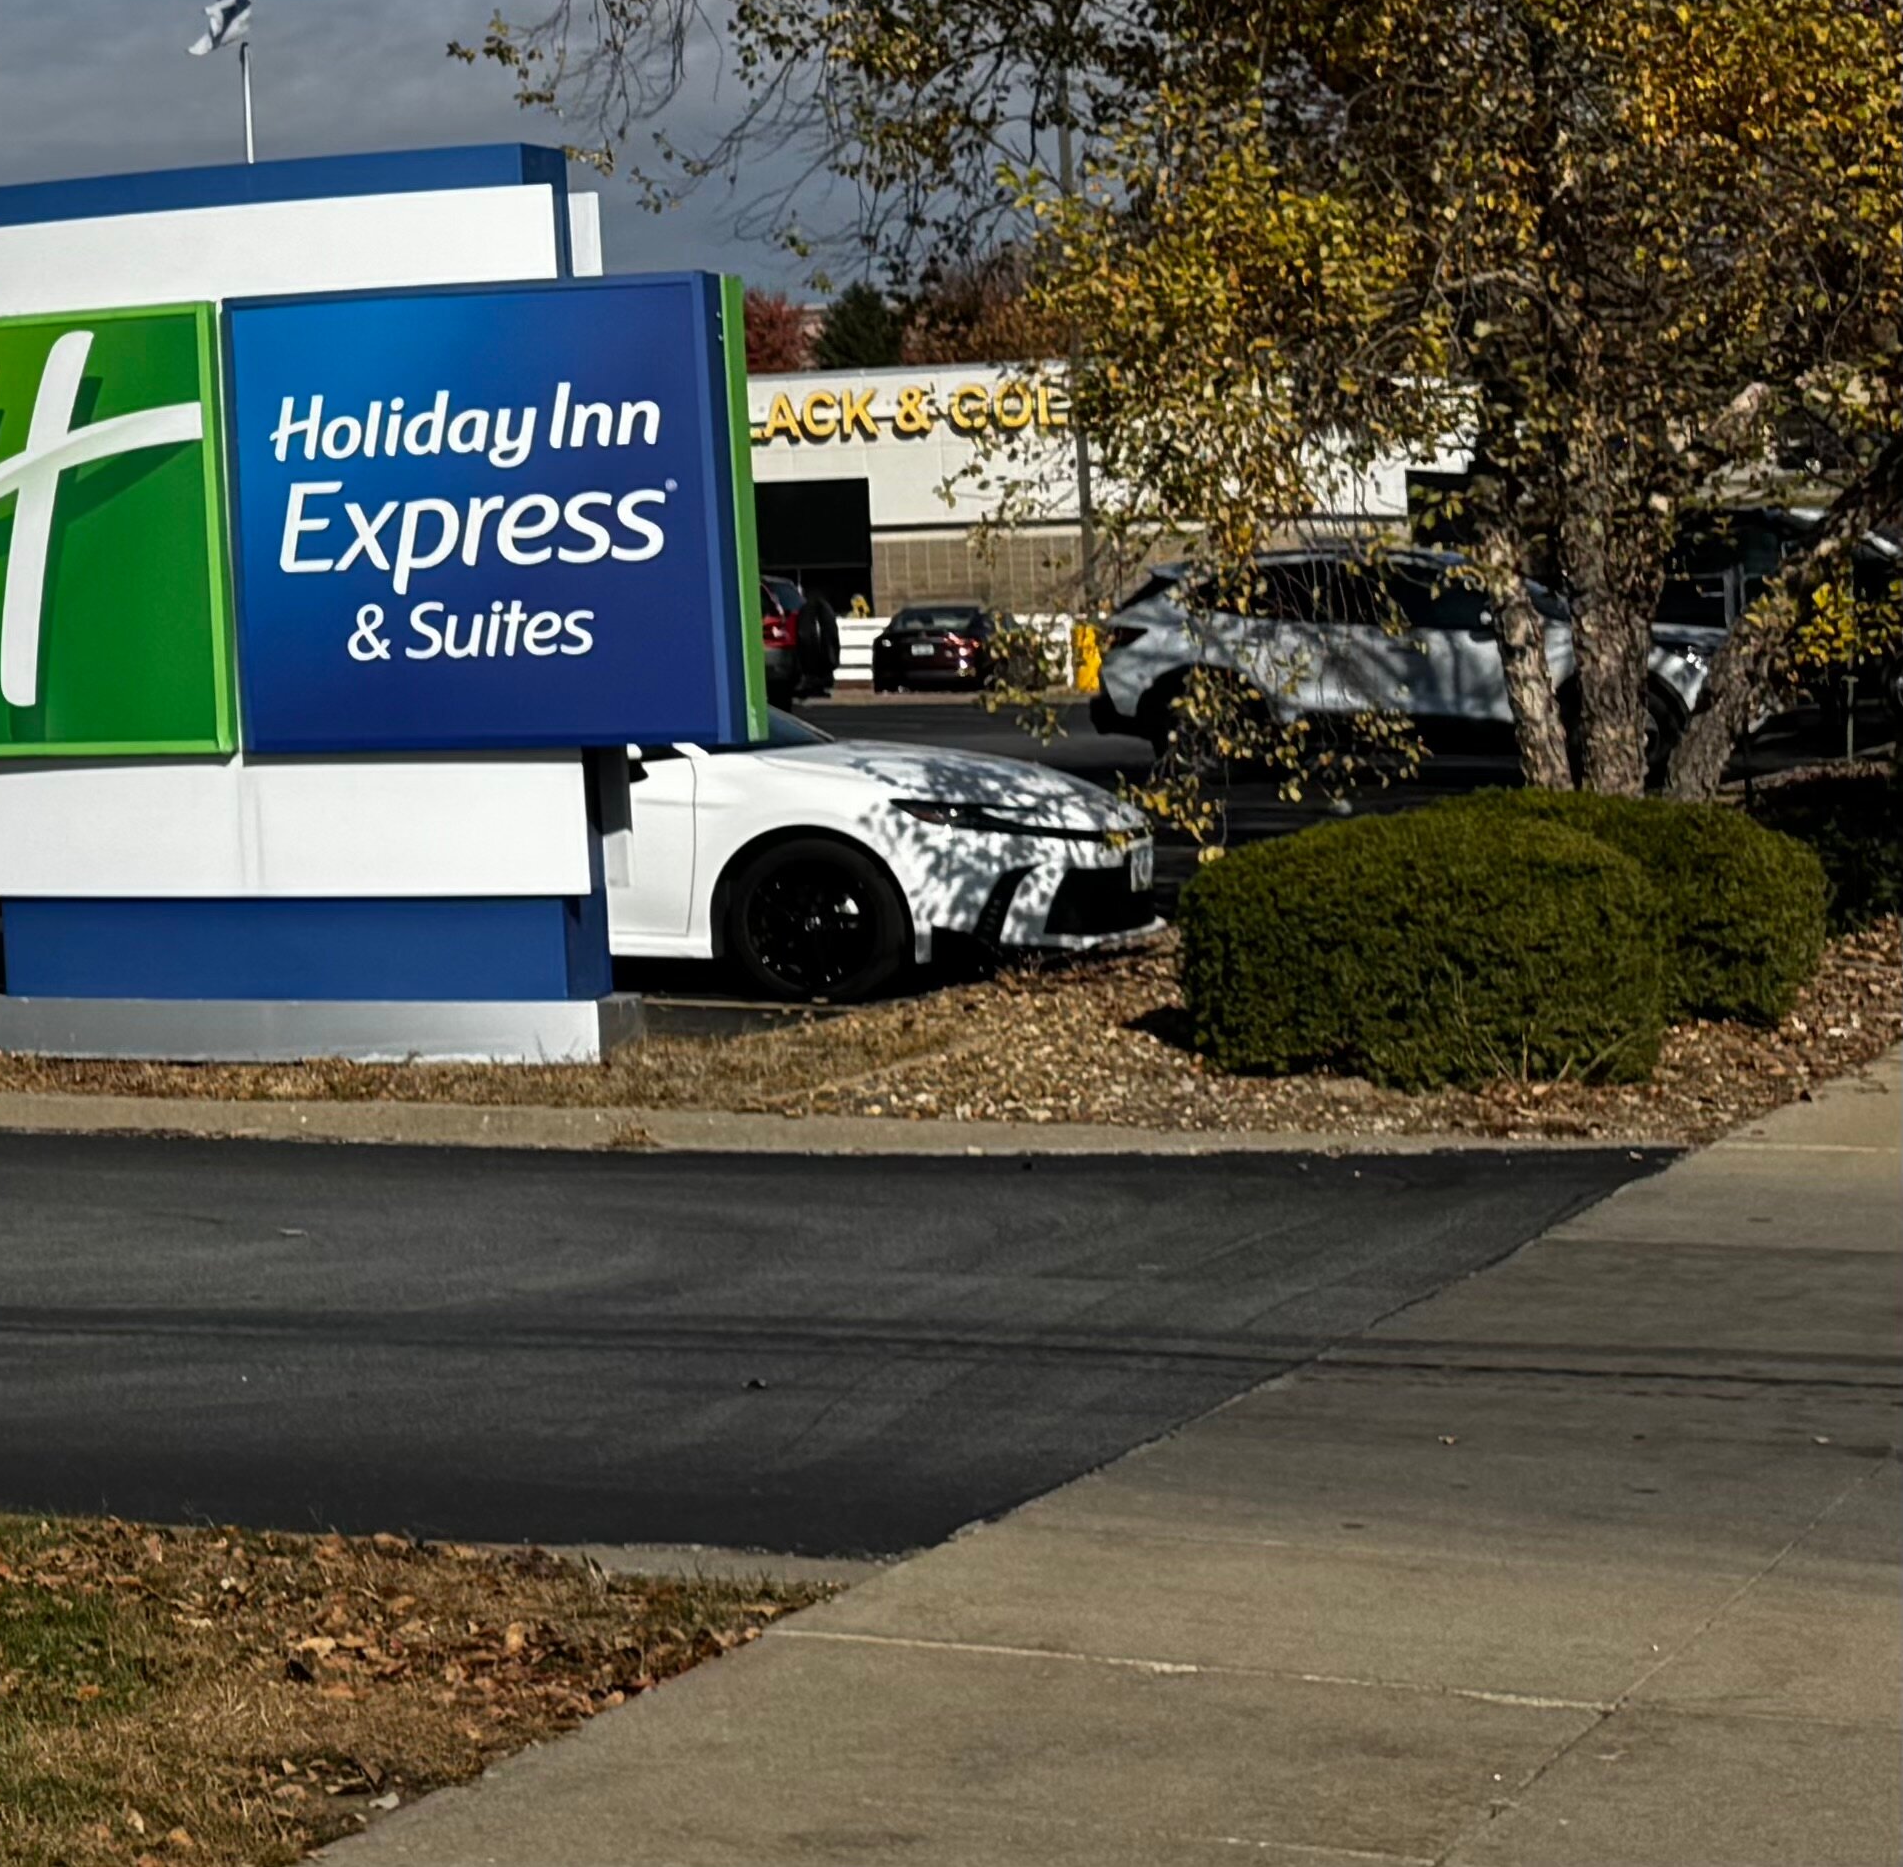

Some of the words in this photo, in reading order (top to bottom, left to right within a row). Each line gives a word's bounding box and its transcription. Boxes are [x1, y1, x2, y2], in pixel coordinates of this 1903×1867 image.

[269, 389, 537, 468] Holiday
[549, 381, 661, 449] Inn
[750, 389, 880, 439] ACK
[895, 386, 932, 433] &
[279, 480, 666, 595] Express
[347, 603, 391, 661] &
[405, 599, 595, 660] Suites
